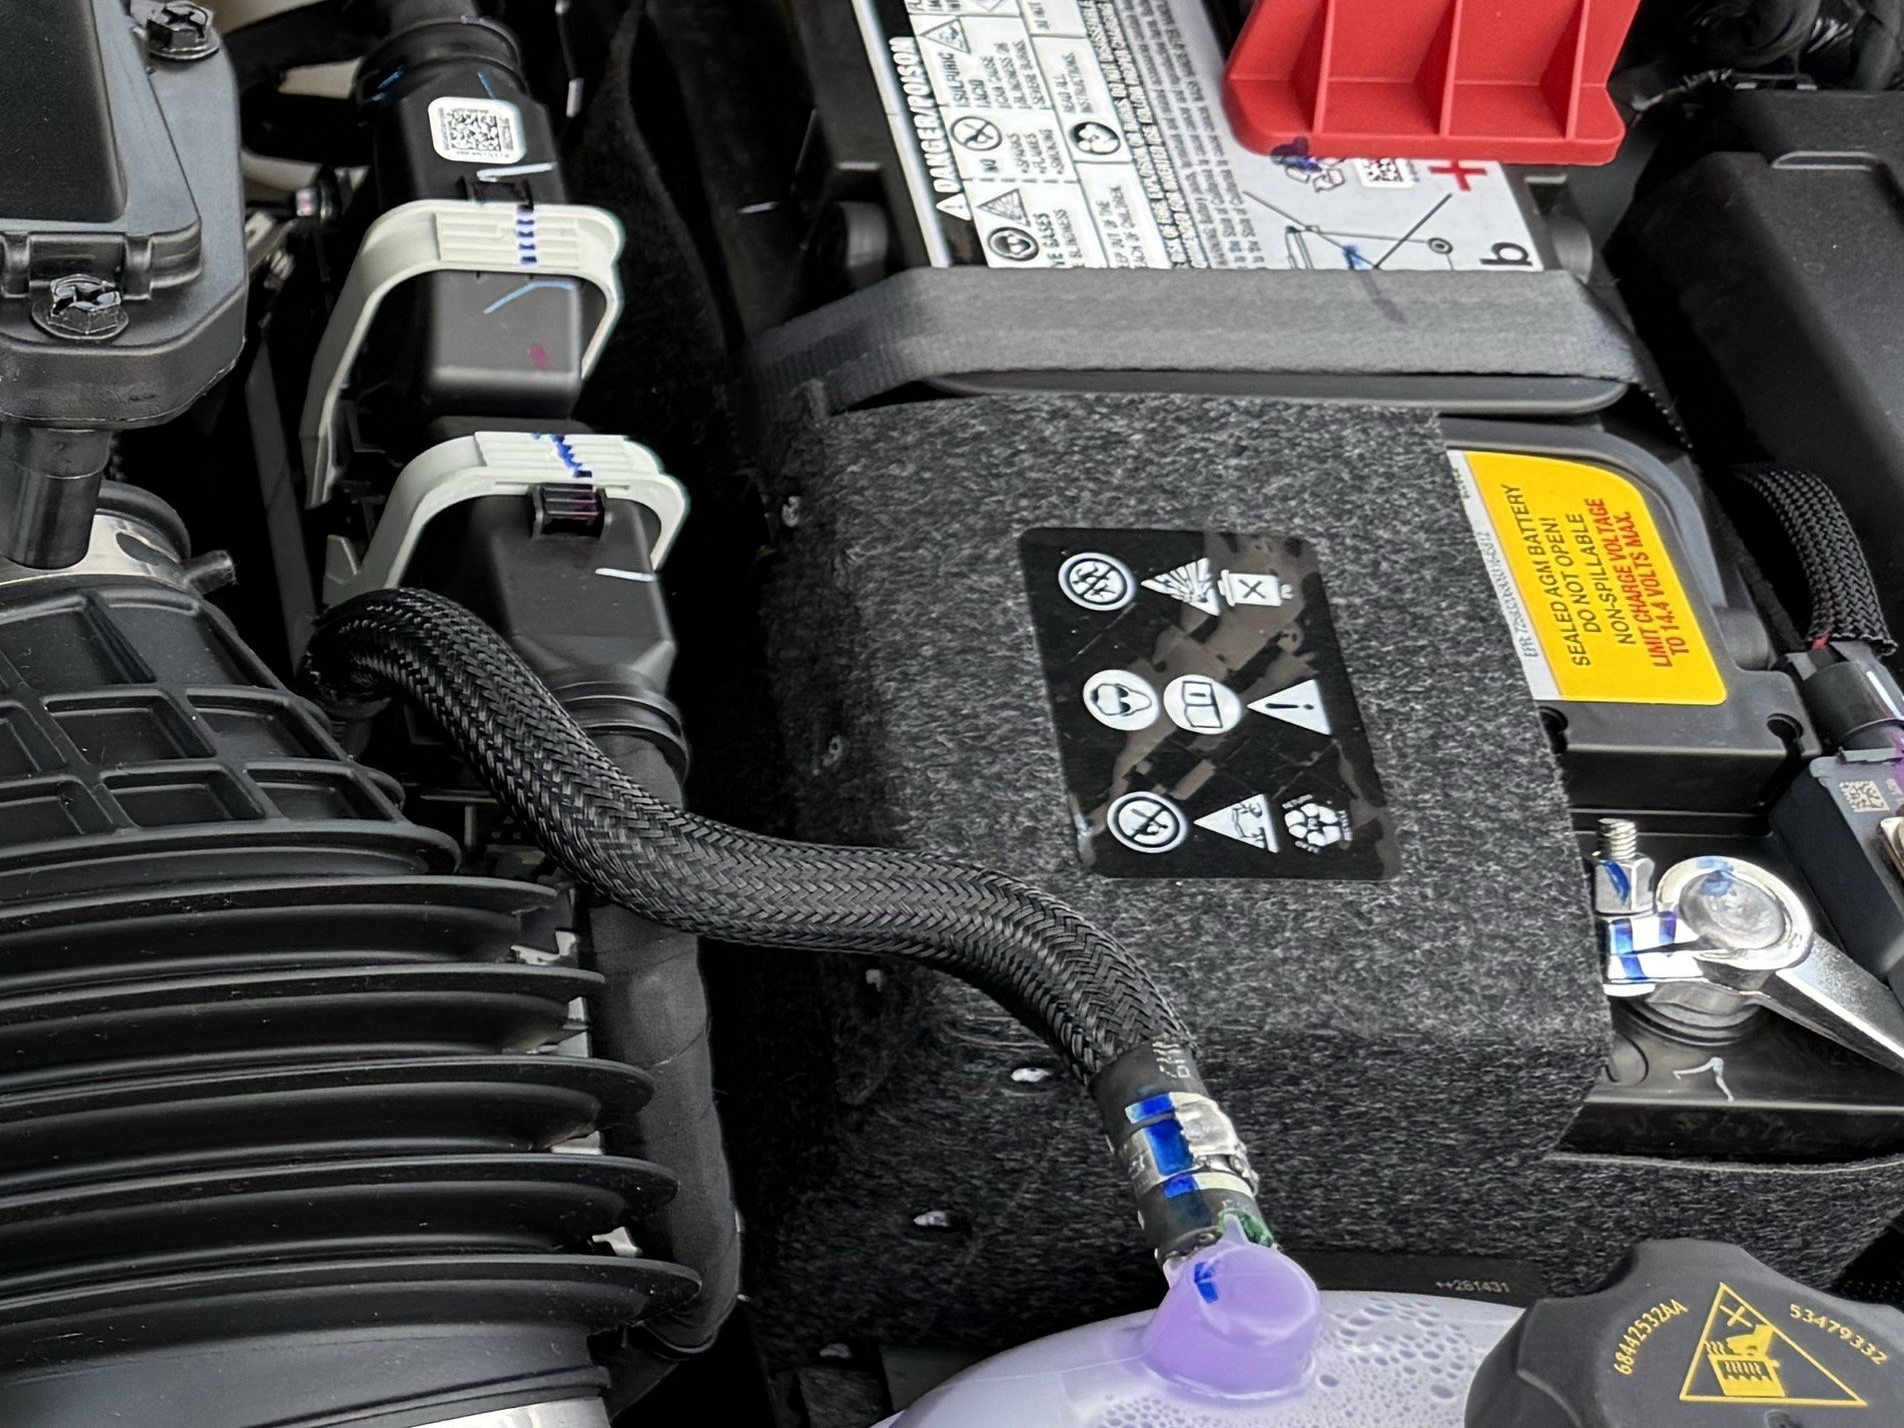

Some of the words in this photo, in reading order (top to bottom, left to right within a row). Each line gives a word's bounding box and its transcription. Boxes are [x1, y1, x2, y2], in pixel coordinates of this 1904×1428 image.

[885, 35, 963, 192] DANGER/POISON
[1500, 482, 1546, 556] BATTERY
[1538, 516, 1576, 567] OPEN!
[1583, 497, 1628, 561] VOLTAGE
[1610, 510, 1645, 548] MAX.
[1531, 559, 1563, 598] AGM
[1560, 570, 1590, 605] NOT
[1564, 512, 1637, 645] NON-SPILLABLE
[1612, 564, 1654, 623] CHARGE
[1628, 551, 1666, 597] VOLTS
[1549, 601, 1592, 666] SEALED
[1575, 608, 1603, 633] DO
[1649, 601, 1680, 631] 14.4
[1638, 627, 1673, 667] LIMIT
[1663, 635, 1691, 655] TO
[1612, 1297, 1690, 1376] 68442532AA
[1789, 1303, 1890, 1367] 53479332
